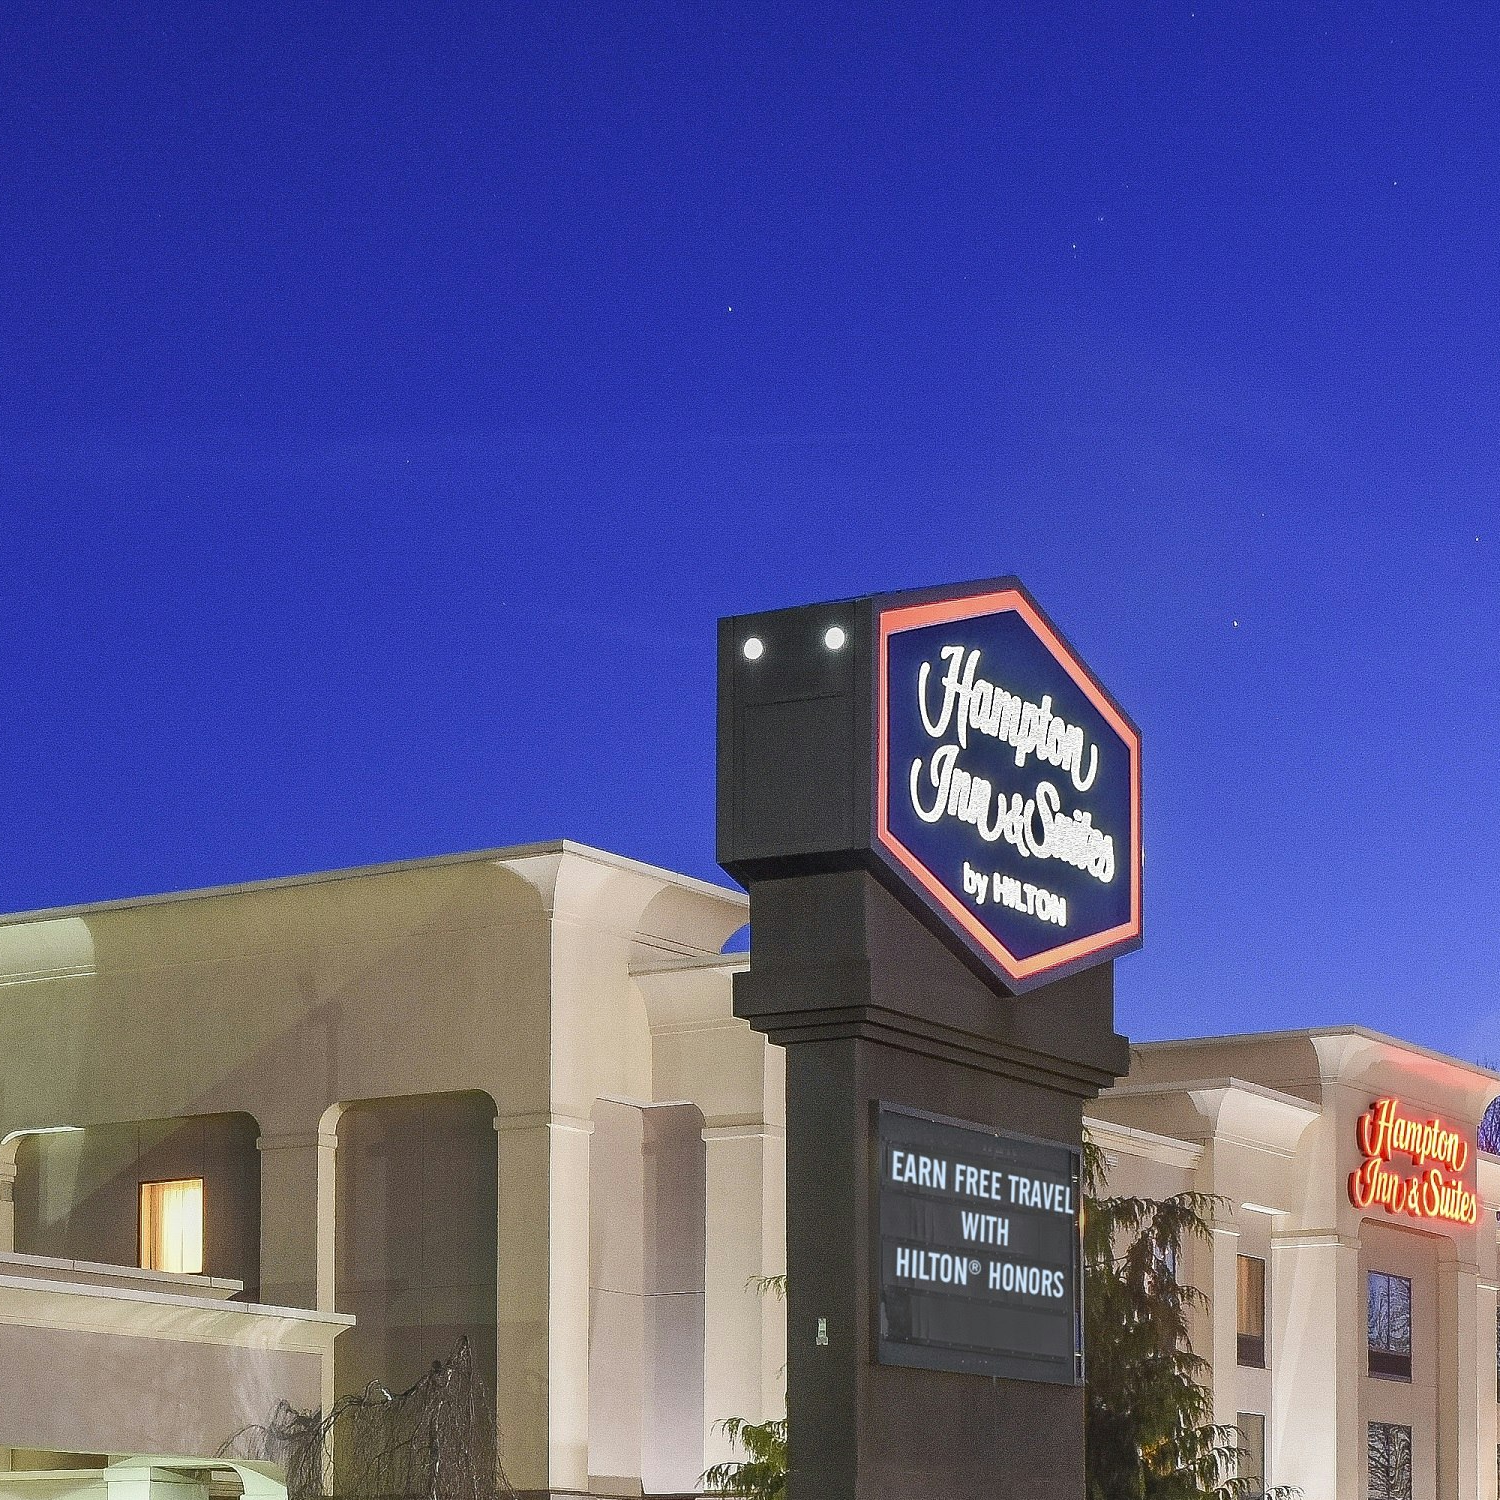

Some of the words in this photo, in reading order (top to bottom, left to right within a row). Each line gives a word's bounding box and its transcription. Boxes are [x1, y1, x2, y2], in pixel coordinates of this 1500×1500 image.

[918, 645, 1098, 792] Hampton
[909, 744, 1007, 842] Inn
[1003, 793, 1031, 857] &
[1024, 781, 1116, 883] Suites
[963, 861, 990, 905] by
[992, 871, 1067, 927] HILTON
[1357, 1098, 1468, 1172] Hampton
[892, 1150, 947, 1190] EARN
[954, 1163, 1003, 1201] FREE
[1008, 1174, 1075, 1215] TRAVEL
[1350, 1158, 1407, 1214] Inn
[1408, 1178, 1422, 1216] &
[1423, 1168, 1478, 1225] Suites
[961, 1210, 1009, 1247] WITH
[988, 1261, 1065, 1298] HONORS
